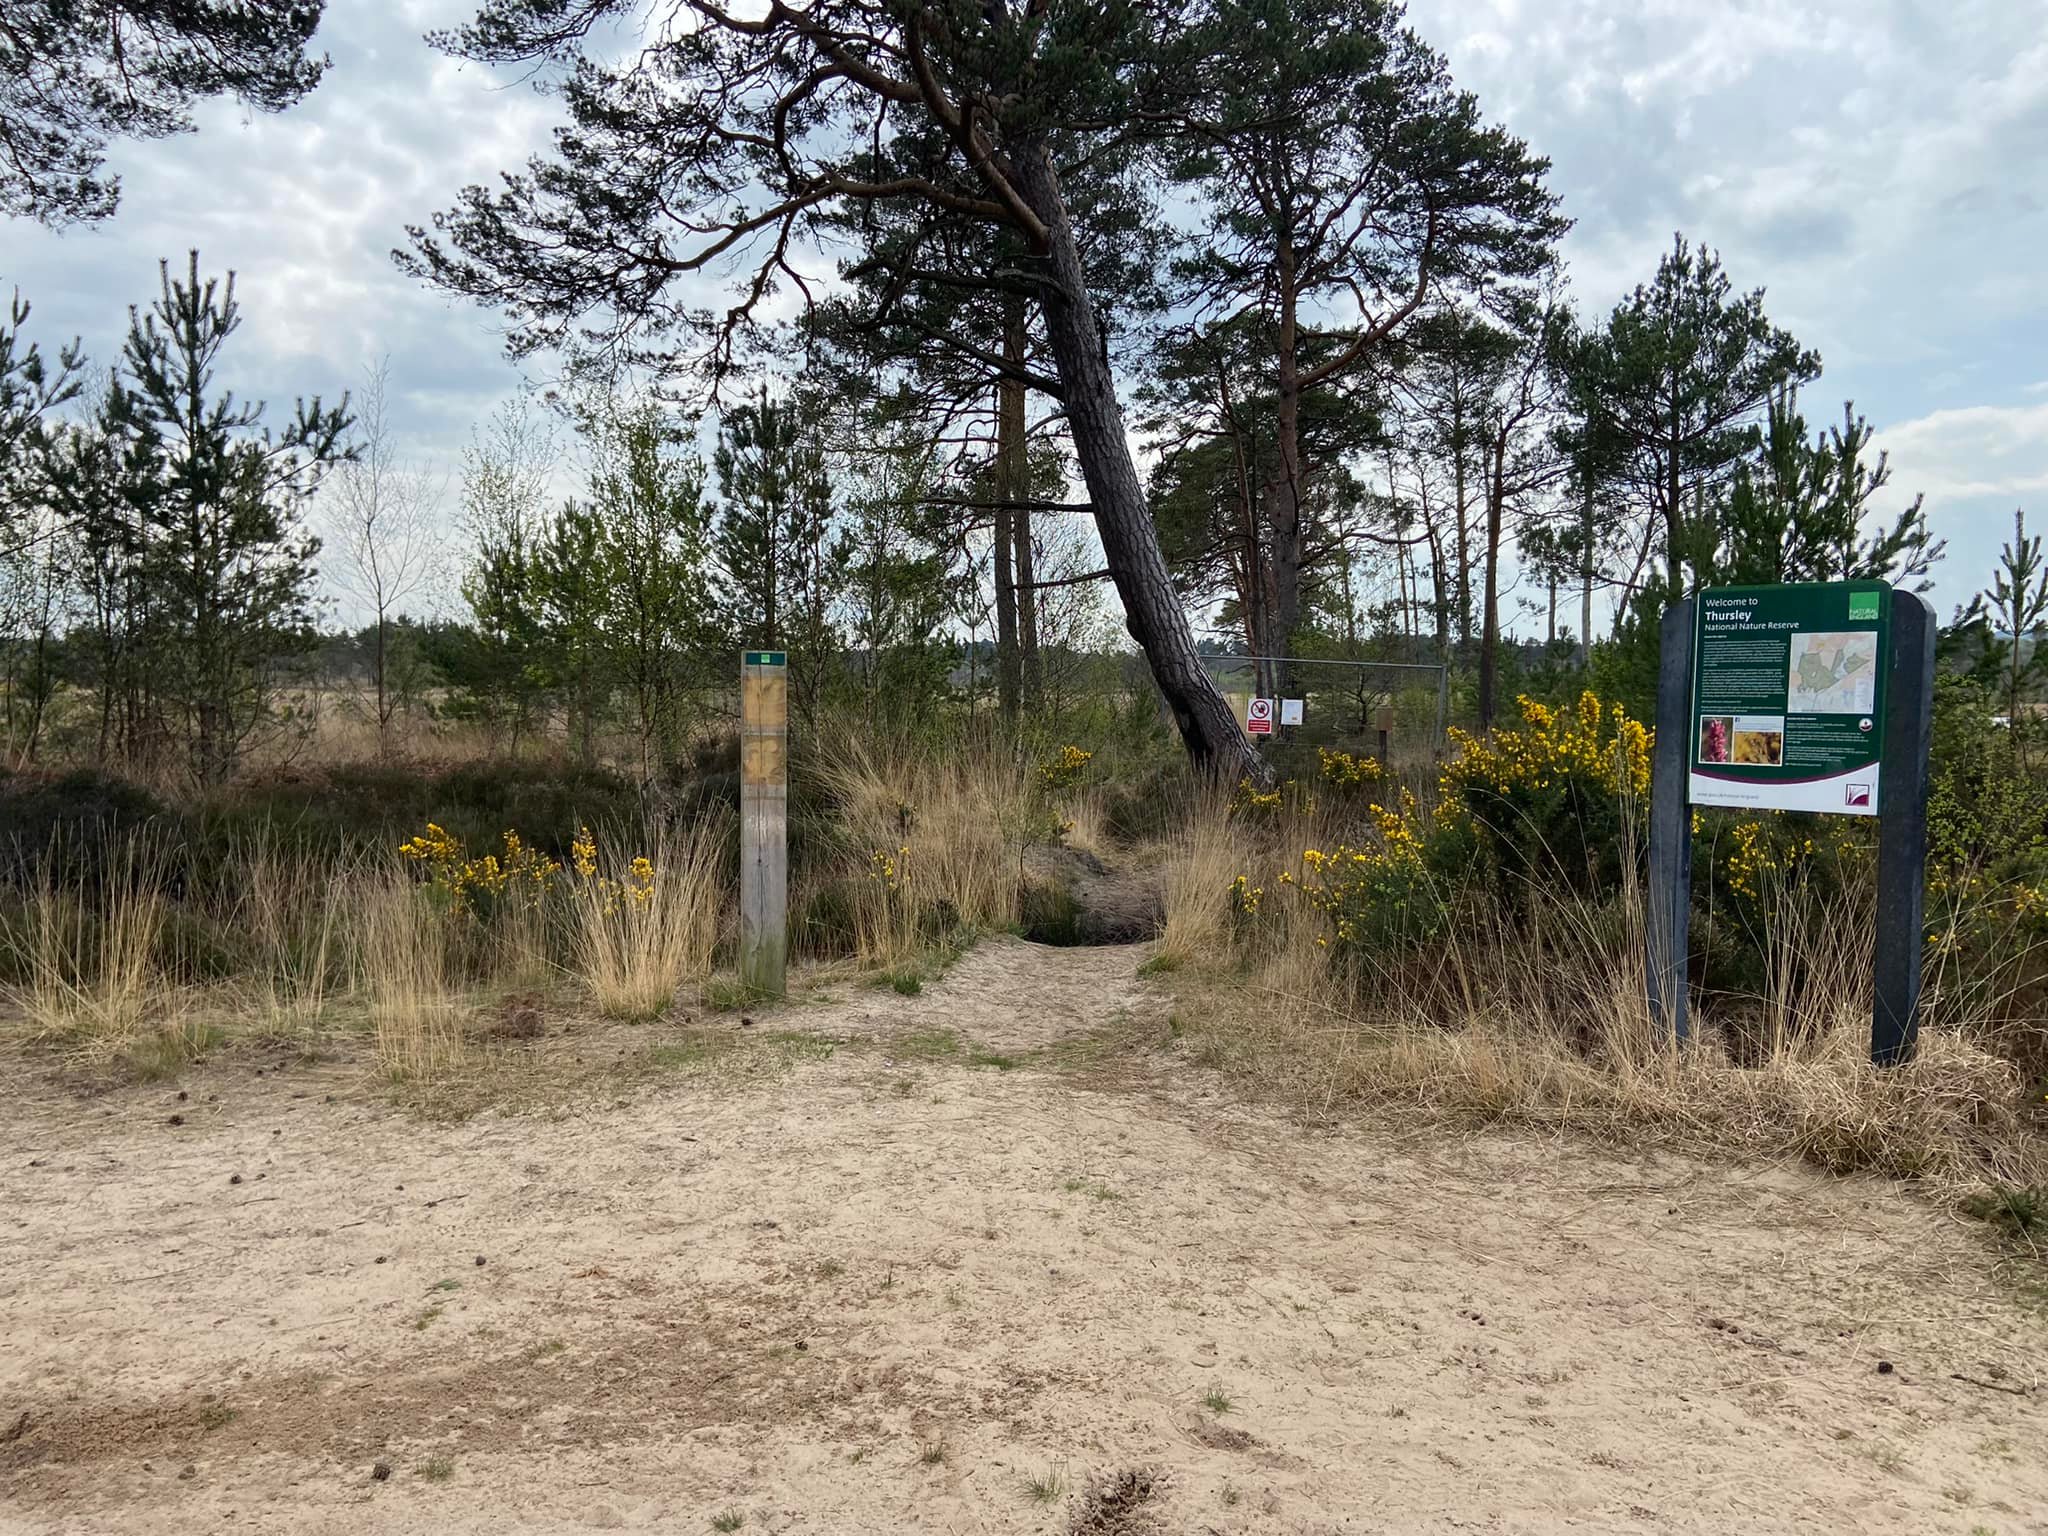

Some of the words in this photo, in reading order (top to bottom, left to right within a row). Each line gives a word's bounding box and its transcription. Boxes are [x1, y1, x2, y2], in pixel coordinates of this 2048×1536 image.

[1705, 598, 1747, 607] Welcome
[1749, 597, 1759, 606] to
[1704, 610, 1752, 622] Thursley
[1704, 622, 1738, 631] National
[1739, 622, 1767, 631] Nature
[1767, 621, 1800, 630] Reserve
